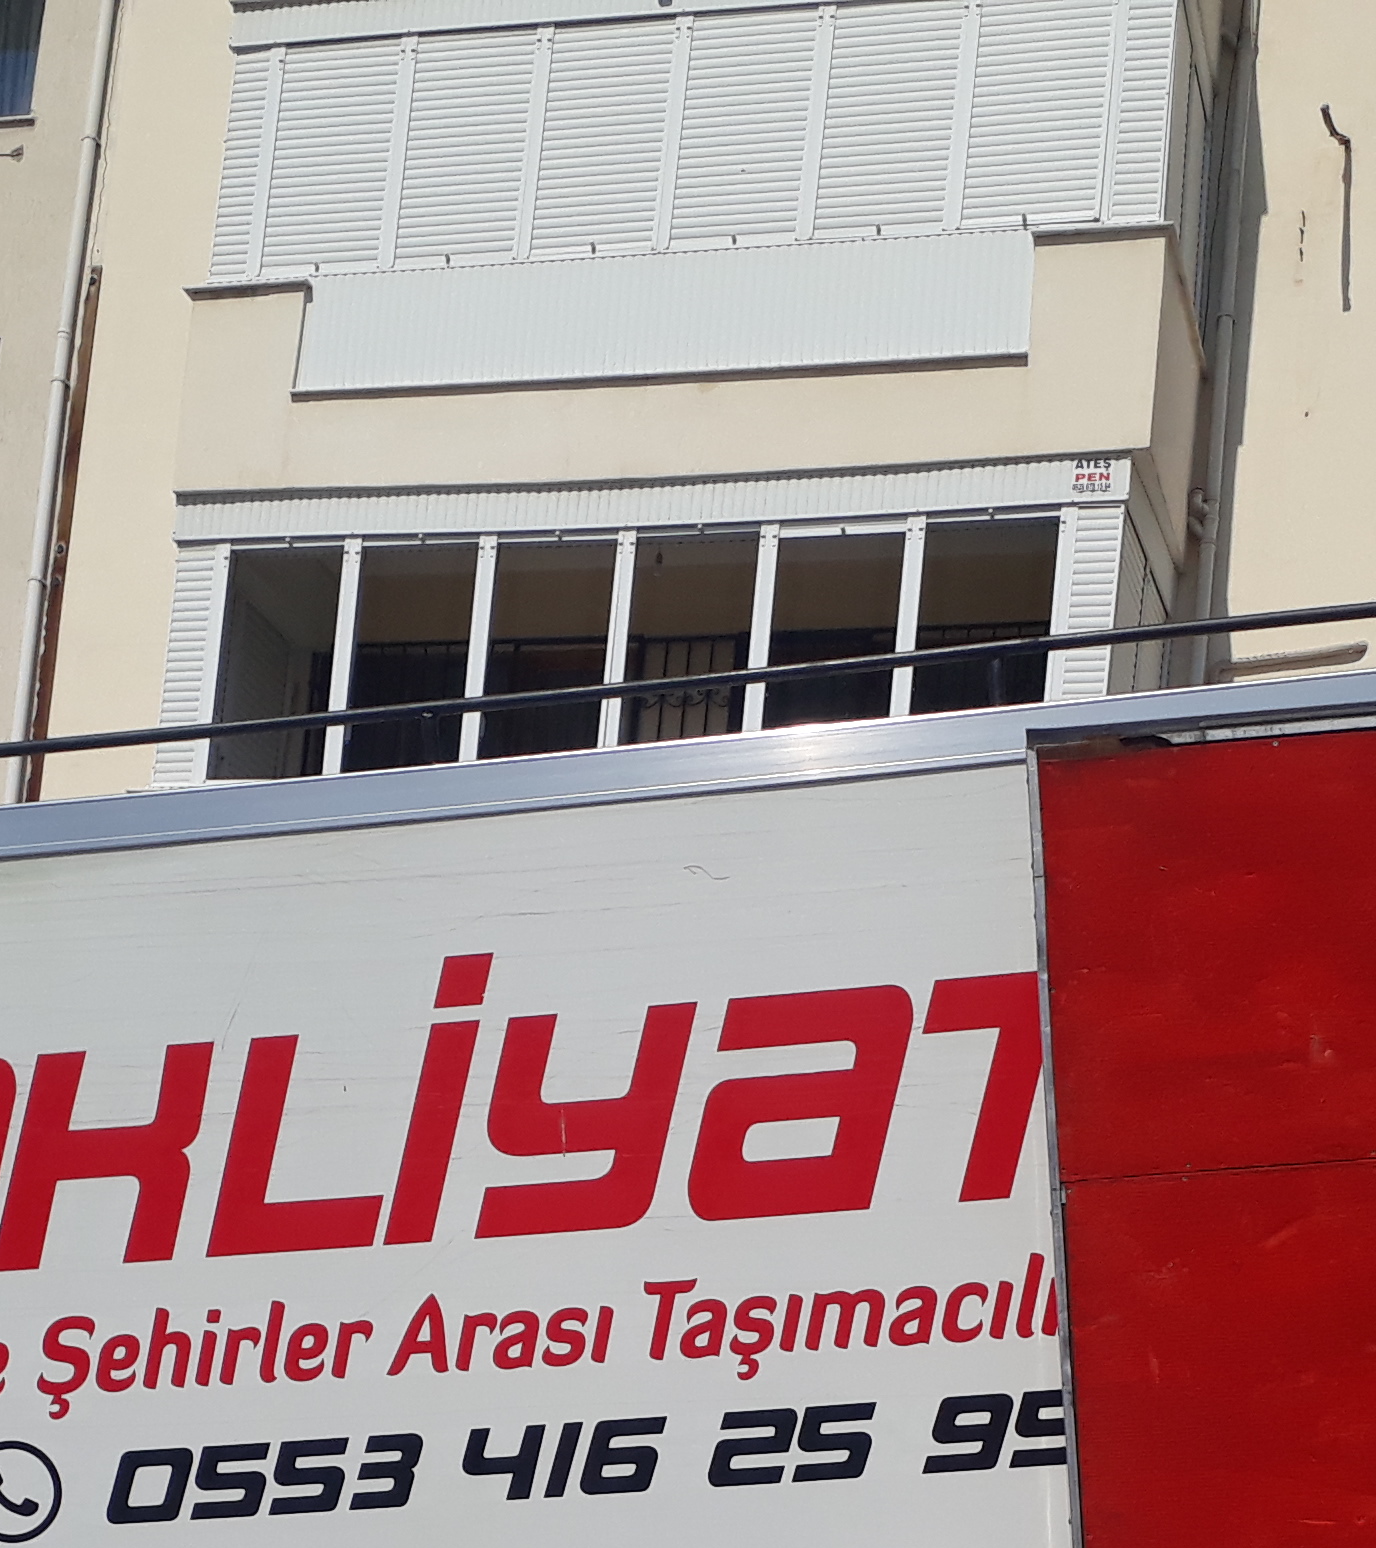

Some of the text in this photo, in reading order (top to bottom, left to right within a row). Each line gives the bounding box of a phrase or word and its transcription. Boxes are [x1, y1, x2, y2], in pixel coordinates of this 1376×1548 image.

[1074, 472, 1111, 483] PEN
[1075, 458, 1112, 471] ATEŞ
[38, 1302, 373, 1419] Şehirler
[389, 1296, 614, 1375] Arası
[645, 1254, 1060, 1380] Taşımacılı
[107, 1433, 423, 1524] 0553
[463, 1416, 667, 1500] 416
[708, 1402, 876, 1487] 25
